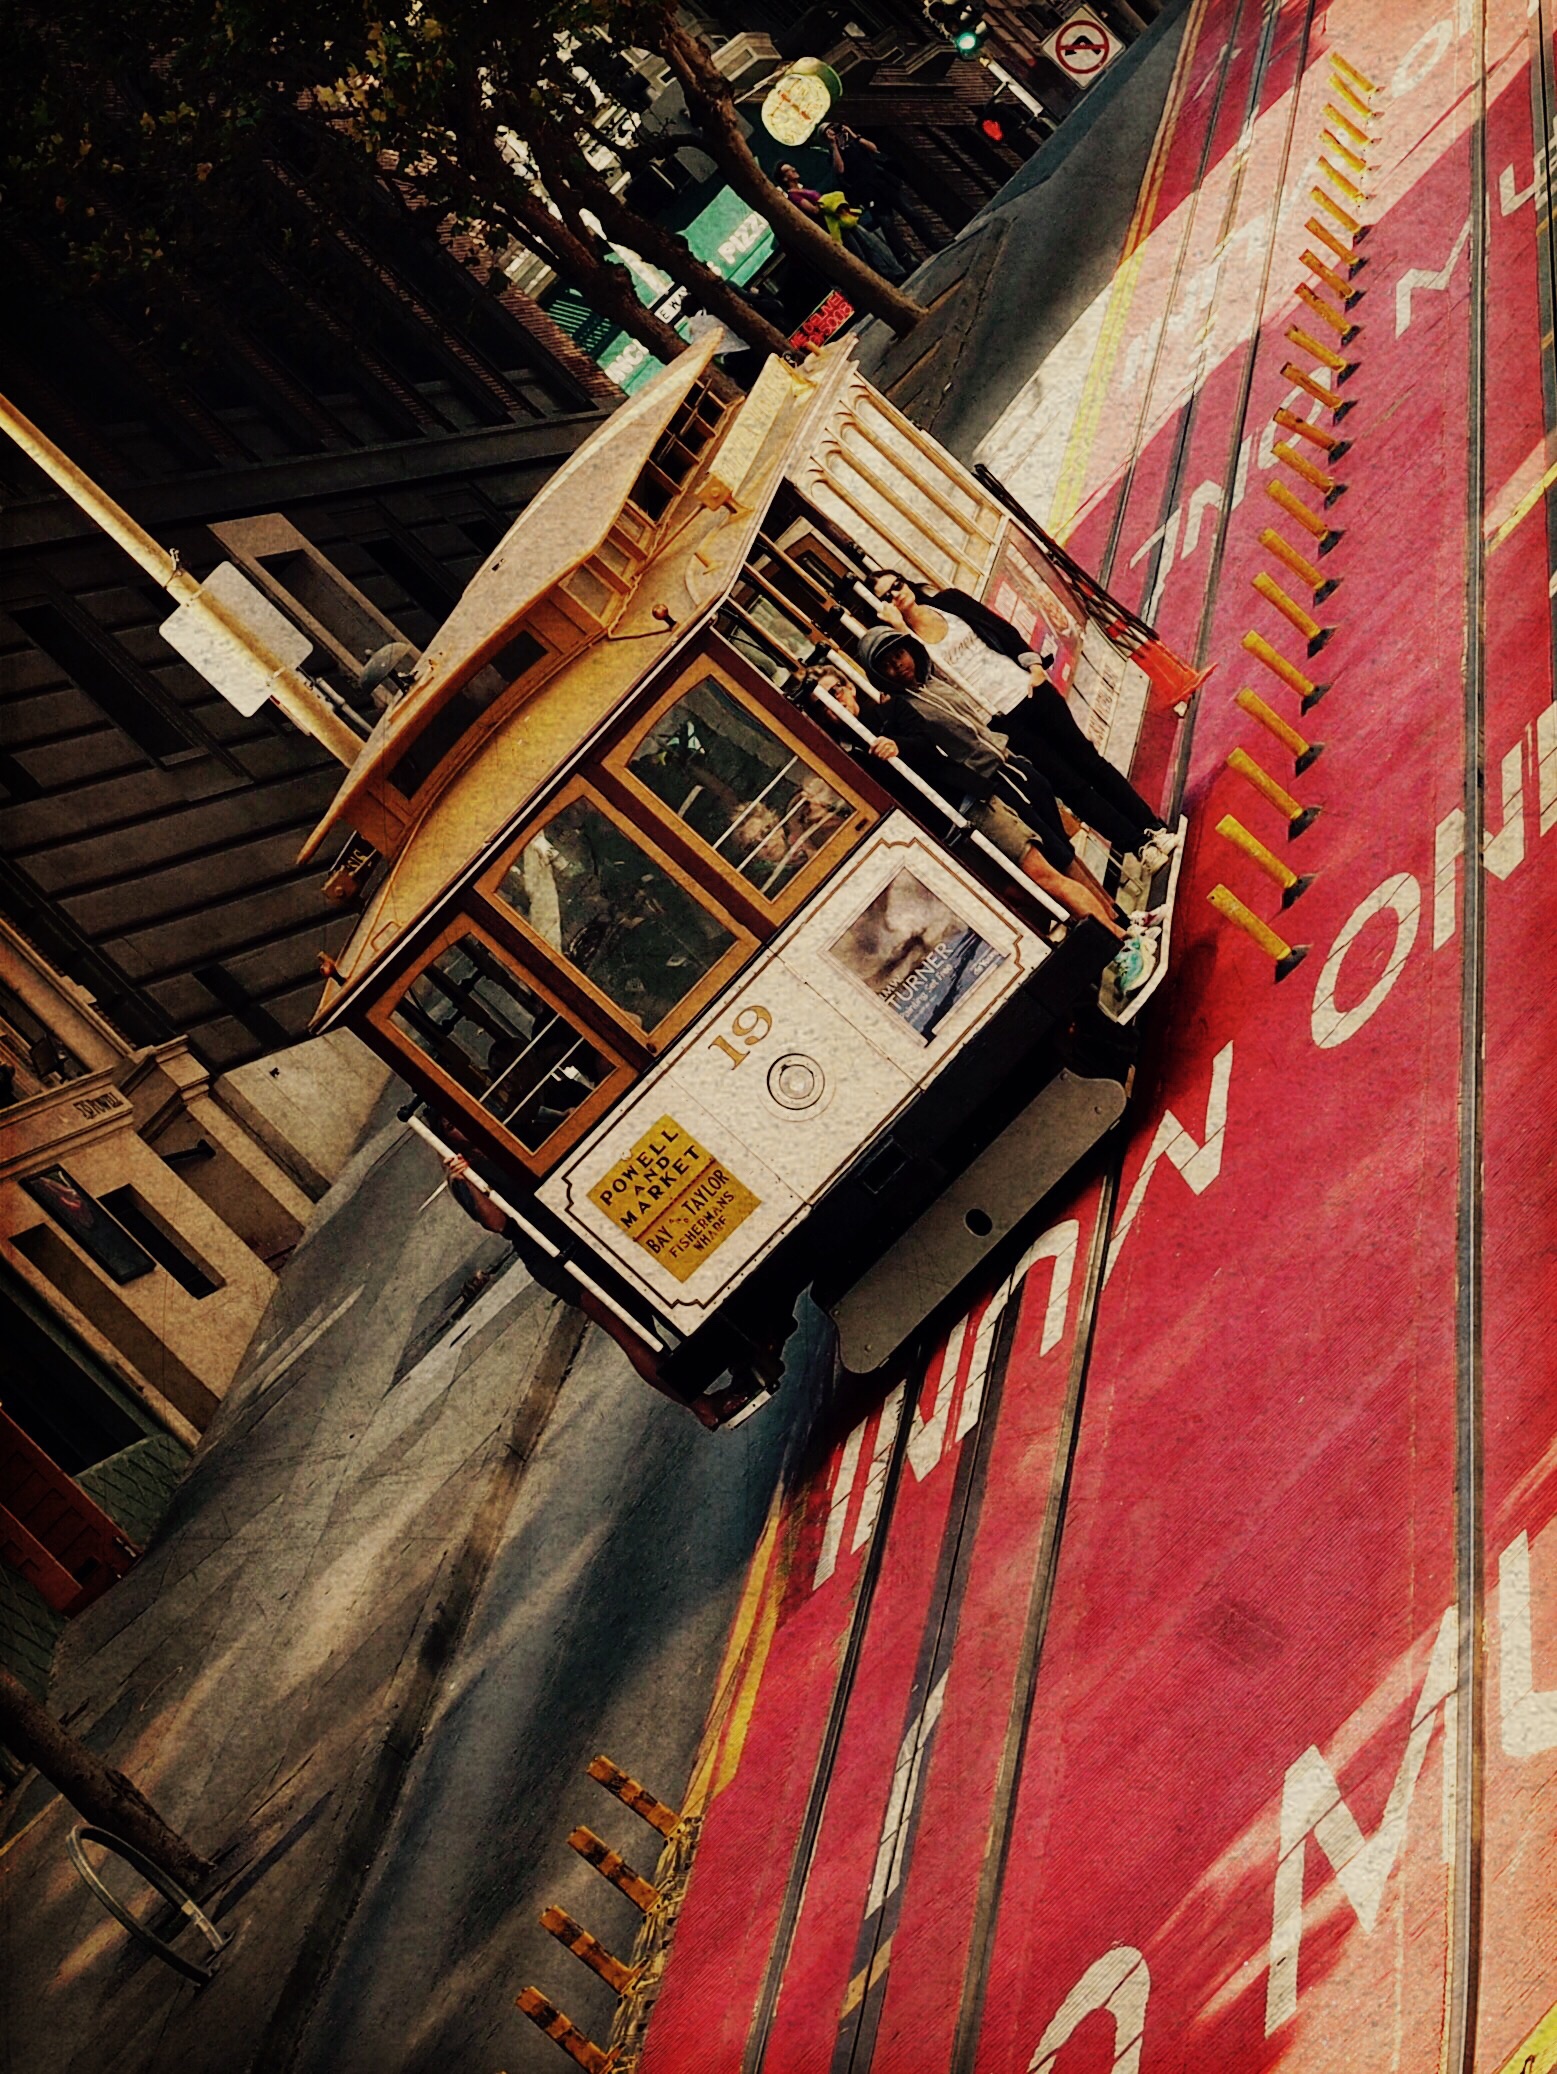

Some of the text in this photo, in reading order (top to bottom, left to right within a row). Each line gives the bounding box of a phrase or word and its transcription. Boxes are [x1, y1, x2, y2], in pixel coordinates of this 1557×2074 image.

[886, 942, 954, 1010] TURNER
[708, 1006, 773, 1070] 19
[600, 1130, 679, 1206] POWELL
[620, 1145, 700, 1229] MARKET
[635, 1156, 670, 1196] AND
[646, 1226, 674, 1255] BAY
[681, 1169, 730, 1217] TAYLOR
[668, 1190, 735, 1259] FISHERMANS
[693, 1215, 729, 1253] WHARF
